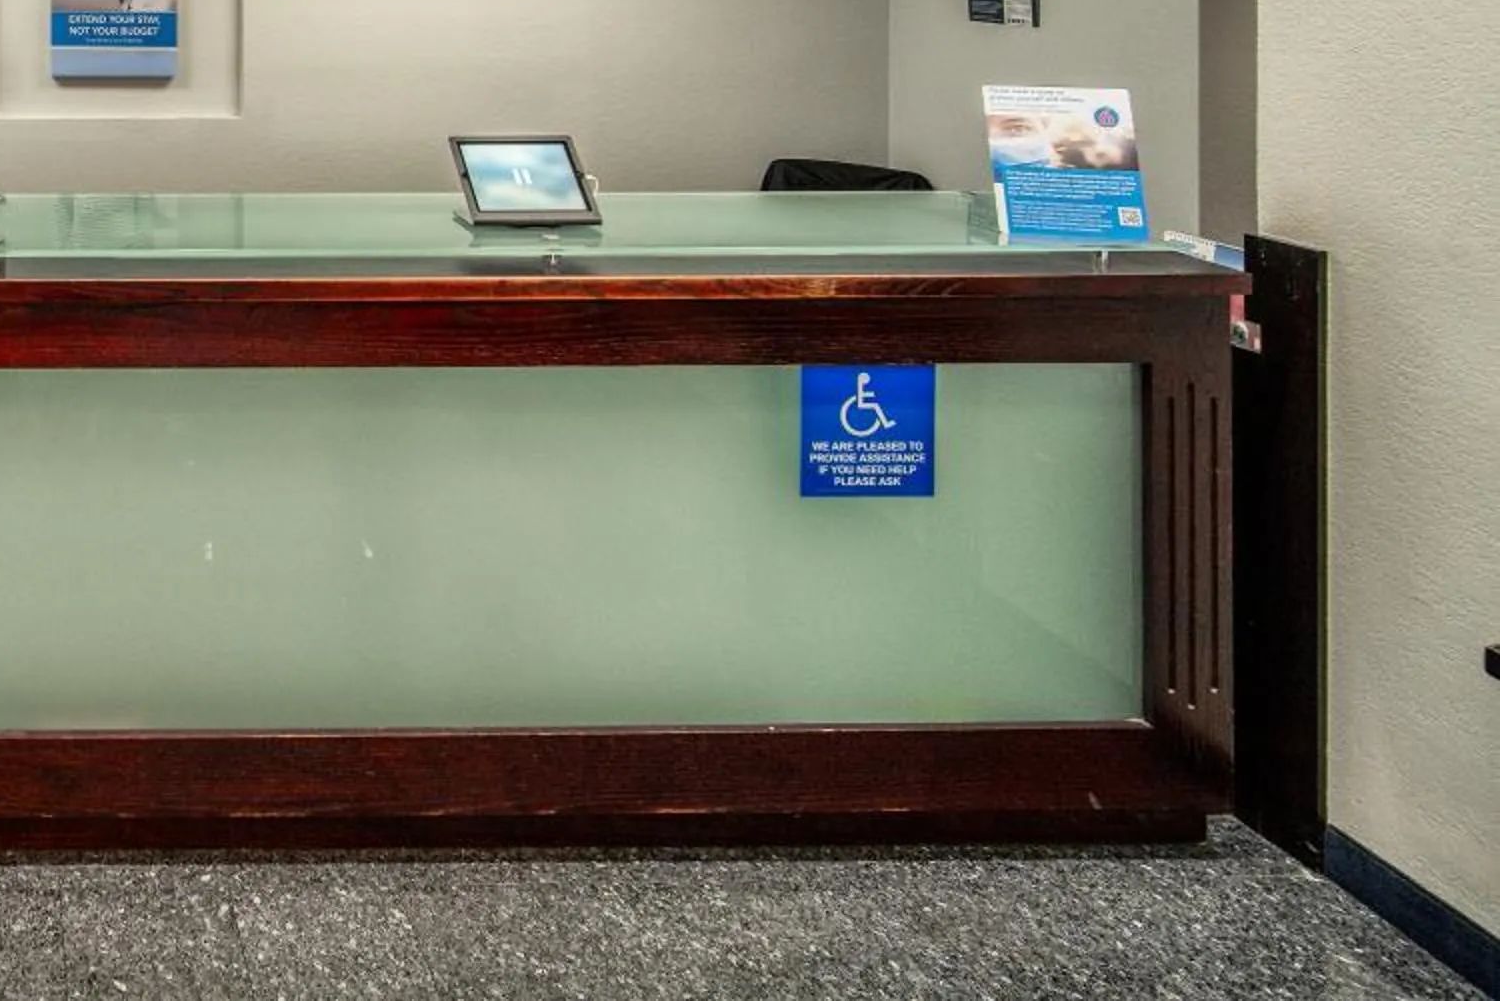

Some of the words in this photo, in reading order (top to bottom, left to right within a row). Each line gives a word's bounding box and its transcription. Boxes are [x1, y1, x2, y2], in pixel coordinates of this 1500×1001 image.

[68, 14, 107, 24] EXTEND
[110, 14, 135, 24] YOUR
[69, 26, 90, 36] NOT
[92, 26, 118, 36] YOUR
[120, 26, 159, 36] BUDGET
[811, 441, 829, 452] WE
[831, 441, 855, 452] ARE
[856, 441, 907, 452] PLEASED
[909, 441, 924, 452] TO
[809, 453, 857, 464] PROVIDE
[859, 453, 926, 463] ASSISTANCE
[819, 465, 829, 475] IF
[831, 465, 854, 475] YOU
[855, 465, 886, 475] NEED
[887, 465, 917, 475] HELP
[833, 476, 876, 487] PLEASE
[878, 476, 901, 486] ASK
